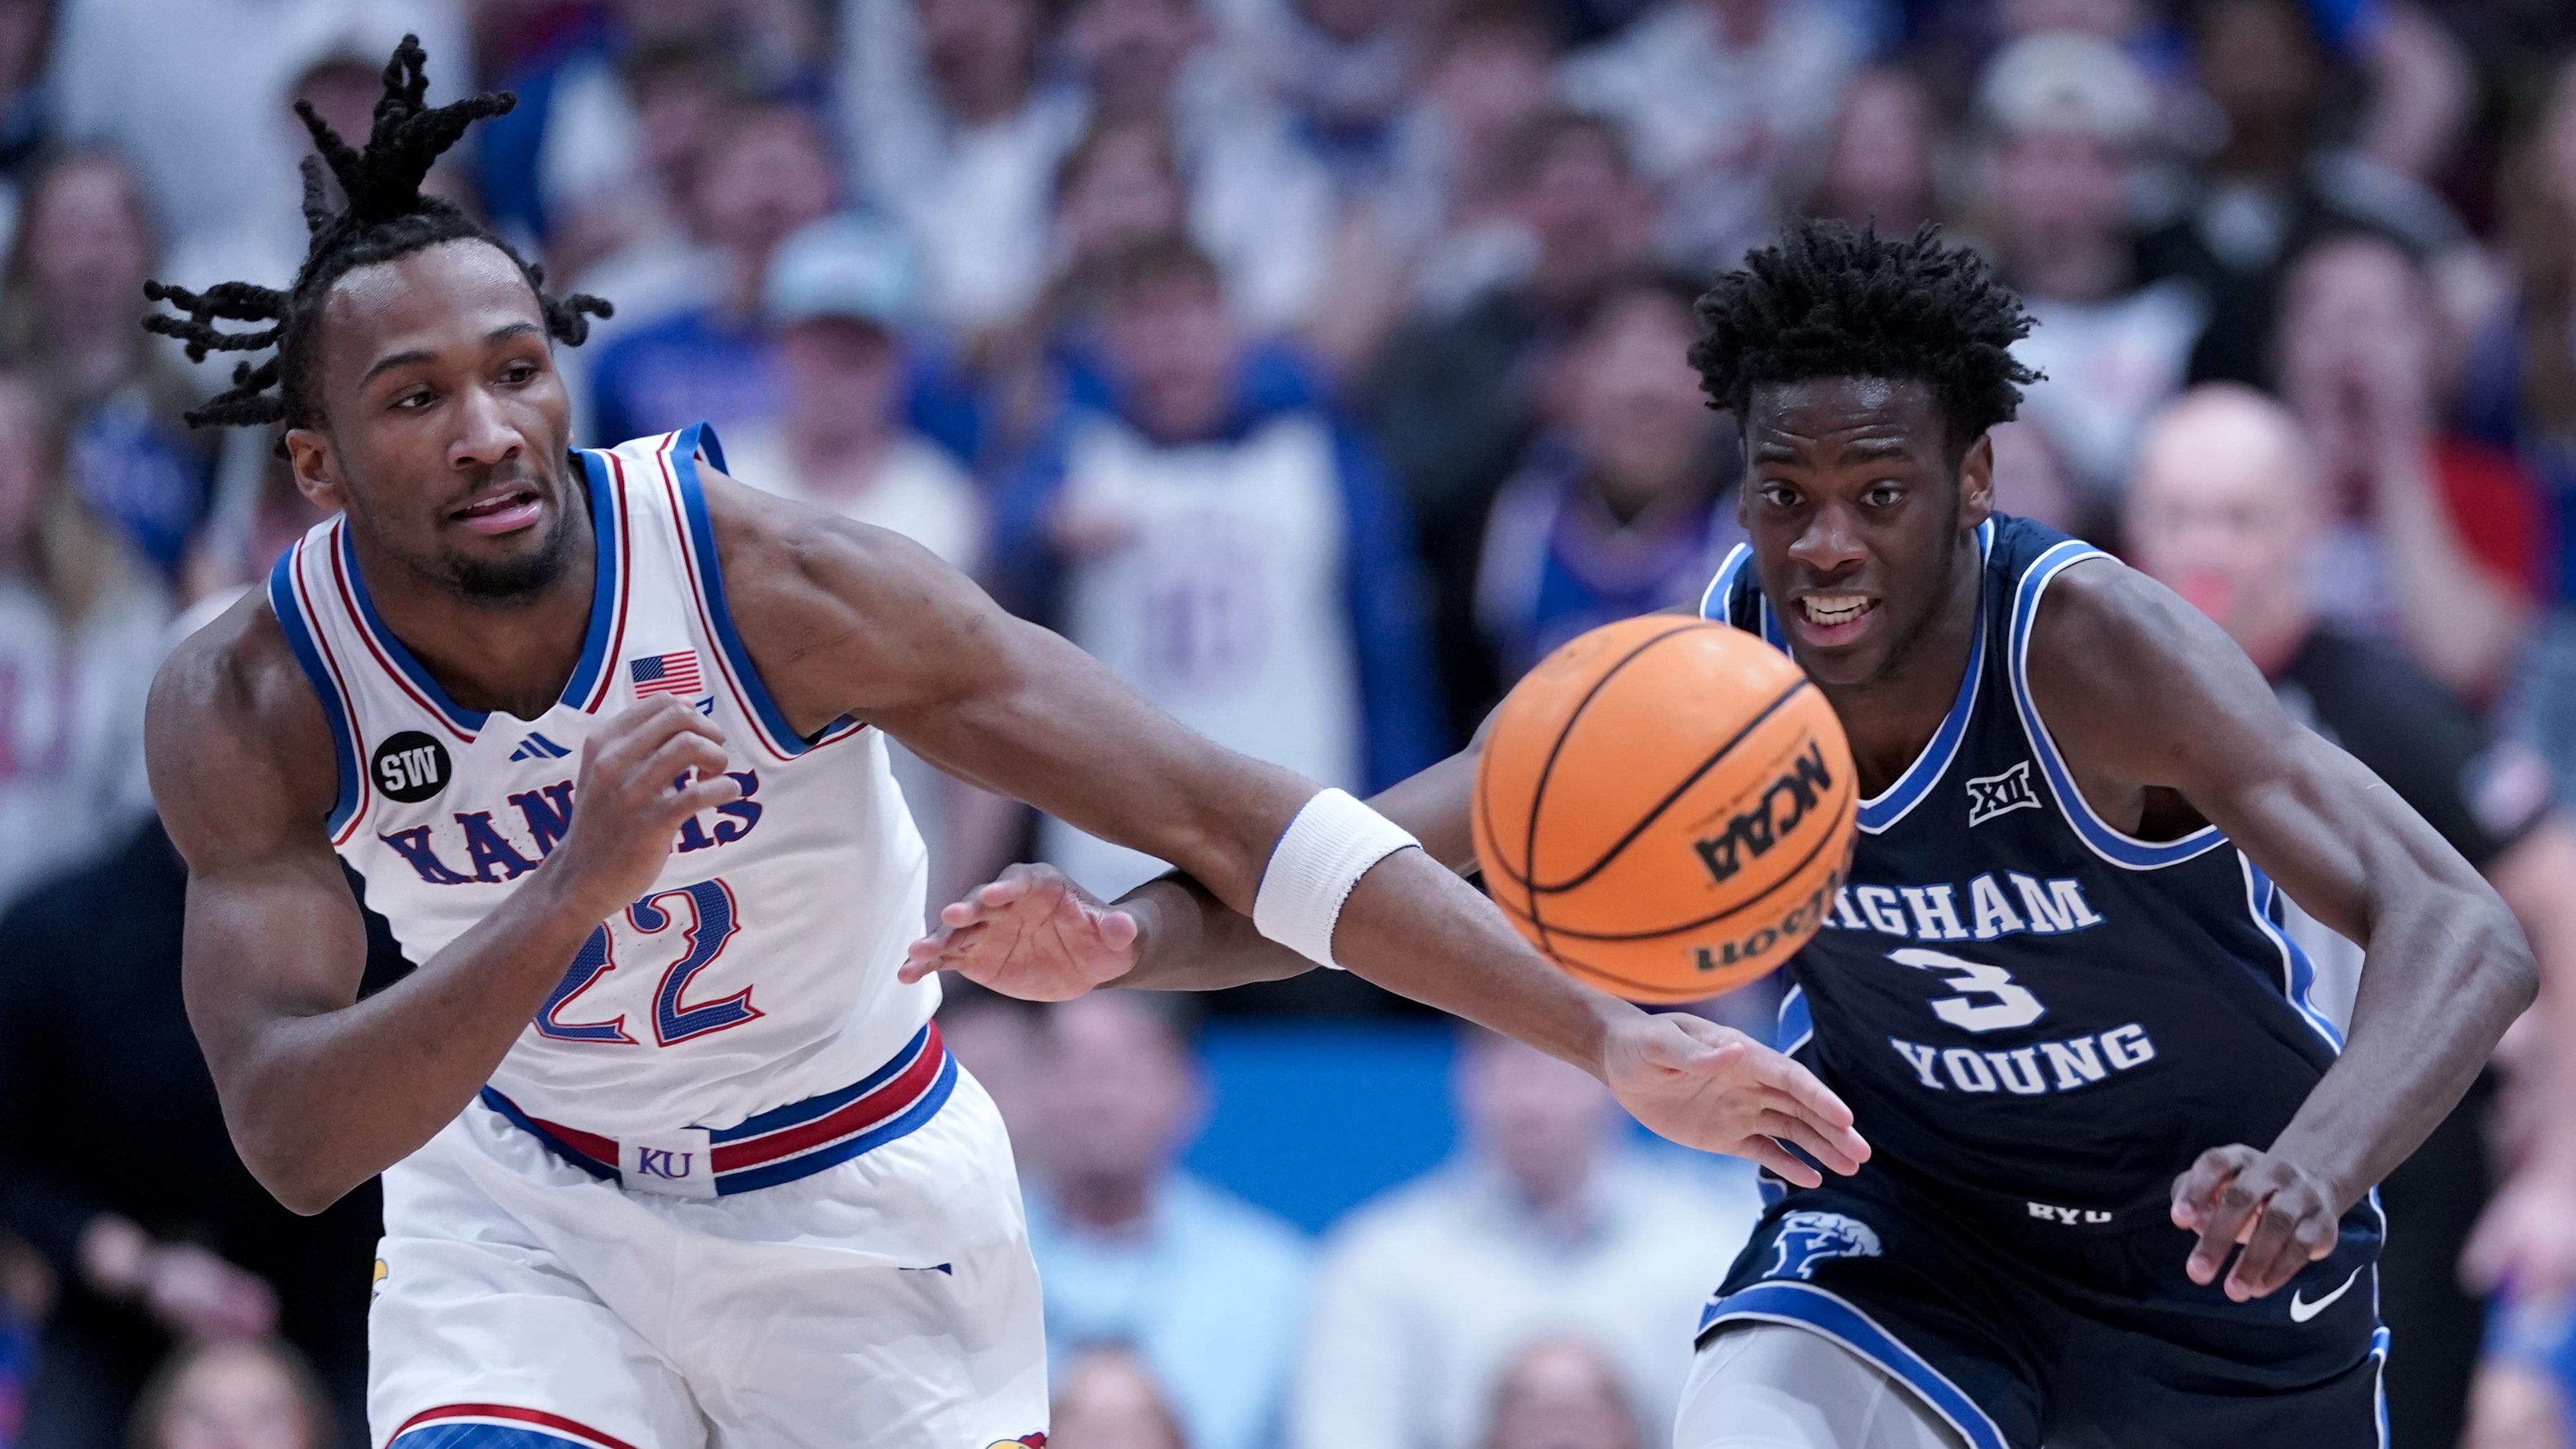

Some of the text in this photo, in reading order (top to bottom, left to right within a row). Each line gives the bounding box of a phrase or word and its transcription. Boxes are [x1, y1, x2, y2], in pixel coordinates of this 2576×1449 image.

[379, 744, 438, 792] SW
[1966, 760, 2043, 828] XII
[377, 768, 763, 885] KANS
[1692, 739, 1832, 884] NCAA
[1820, 870, 2108, 940] IGHAM
[533, 878, 766, 1048] 22
[1882, 948, 2047, 1033] 3
[1888, 1022, 2157, 1095] YOUNG
[638, 1146, 694, 1180] KU
